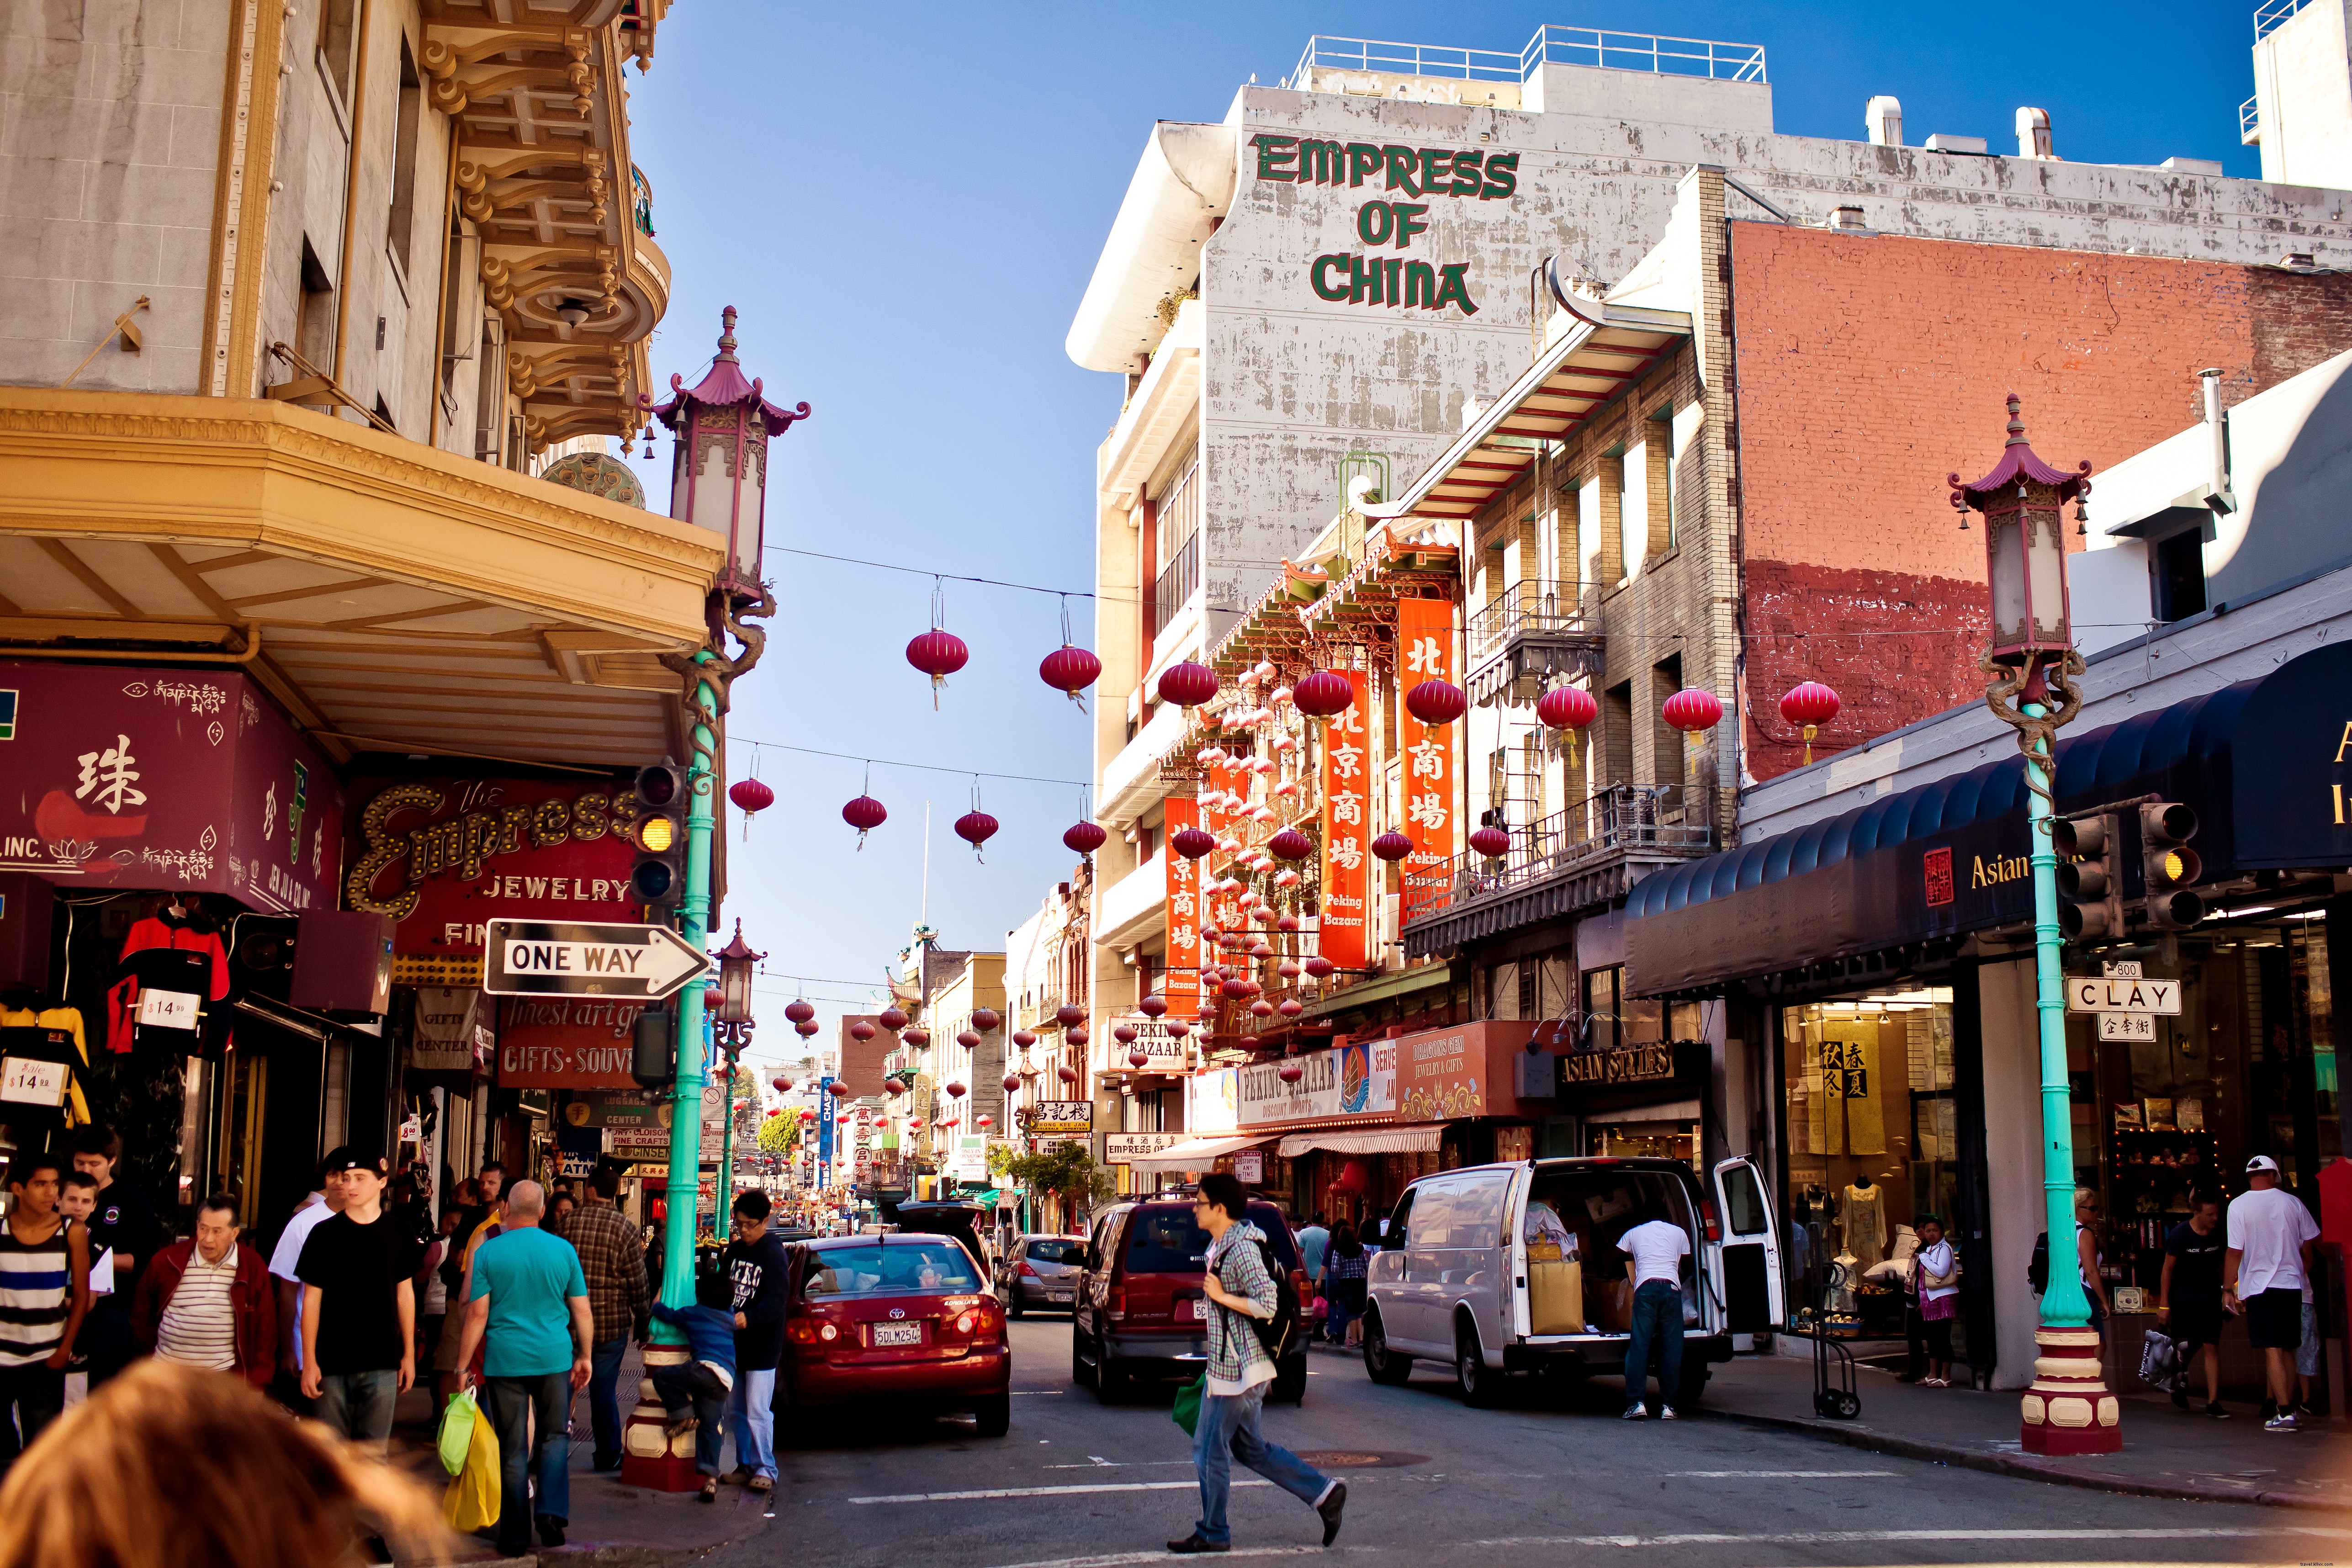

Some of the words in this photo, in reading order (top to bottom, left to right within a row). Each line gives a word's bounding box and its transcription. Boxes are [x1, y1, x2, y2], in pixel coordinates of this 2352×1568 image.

[1248, 133, 1520, 201] EMPRESS
[1357, 200, 1429, 249] OF
[1407, 636, 1448, 830] 北商場
[75, 734, 147, 815] 珠
[1407, 850, 1448, 869] Peking
[1972, 854, 2029, 889] Asian
[483, 875, 631, 902] JEWELRY
[1326, 893, 1362, 909] Peking
[1324, 914, 1362, 927] Bazaar
[512, 944, 572, 971] ONE
[583, 947, 644, 974] WAY
[2118, 964, 2136, 975] 800
[1168, 980, 1197, 991] Bazaar
[2081, 984, 2168, 1007] CLAY
[424, 1013, 465, 1025] GIFTS
[575, 999, 614, 1026] art
[1132, 1023, 1171, 1038] PEKIN
[416, 1040, 469, 1052] CENTER
[1130, 1041, 1182, 1056] BAZAAR
[1413, 1038, 1446, 1061] DRAGONS
[1447, 1035, 1465, 1055] GEM
[21, 1063, 46, 1074] Sale
[504, 1047, 564, 1073] GIFTS
[1376, 1048, 1395, 1073] SERVE
[1414, 1061, 1440, 1080] JEWELRY
[1441, 1060, 1445, 1074] &
[1446, 1058, 1464, 1073] GIFTS
[1562, 1053, 1603, 1083] ASIAN
[1244, 1067, 1282, 1102] PEKING
[823, 1089, 832, 1121] CHASE
[1263, 1102, 1287, 1118] DISCOUNT
[1289, 1098, 1312, 1116] IMPORTS
[607, 1115, 641, 1124] CENTER
[1108, 1145, 1151, 1154] EMPRESS
[878, 1330, 917, 1343] 5DLM254
